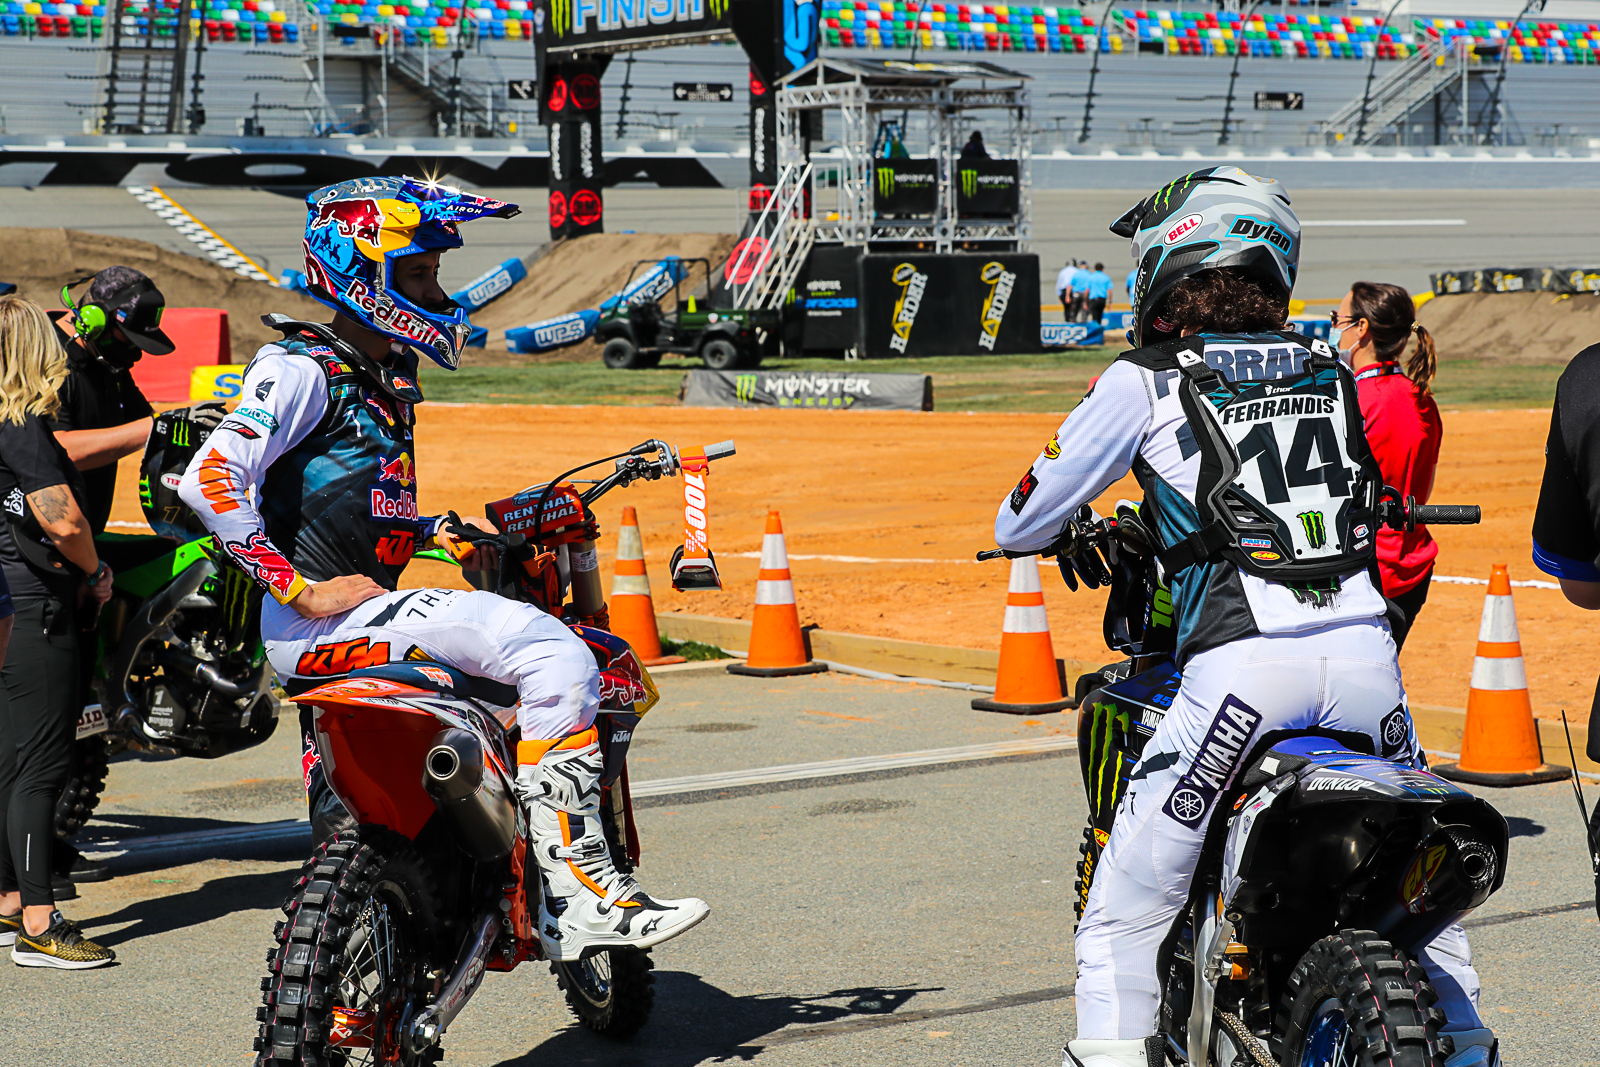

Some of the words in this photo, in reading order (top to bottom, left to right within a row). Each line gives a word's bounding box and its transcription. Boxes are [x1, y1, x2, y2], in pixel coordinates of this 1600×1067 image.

[572, 0, 704, 34] FINISH
[446, 204, 483, 215] AIROH
[1168, 218, 1199, 242] BELL
[1230, 218, 1291, 254] Dylan
[393, 247, 416, 256] AIROH
[467, 270, 513, 306] WPS
[534, 318, 586, 347] WPS
[1041, 326, 1088, 345] WPS
[764, 375, 872, 396] MONSTER
[1272, 386, 1294, 395] thor
[779, 396, 854, 407] ENERGY
[1223, 397, 1335, 425] FERRANDIS
[1236, 416, 1355, 506] 14
[684, 472, 707, 553] 100%
[295, 635, 391, 677] KTM
[611, 730, 632, 744] KTM
[1183, 703, 1258, 791] YAMAHA
[1306, 777, 1376, 792] DUNLOP
